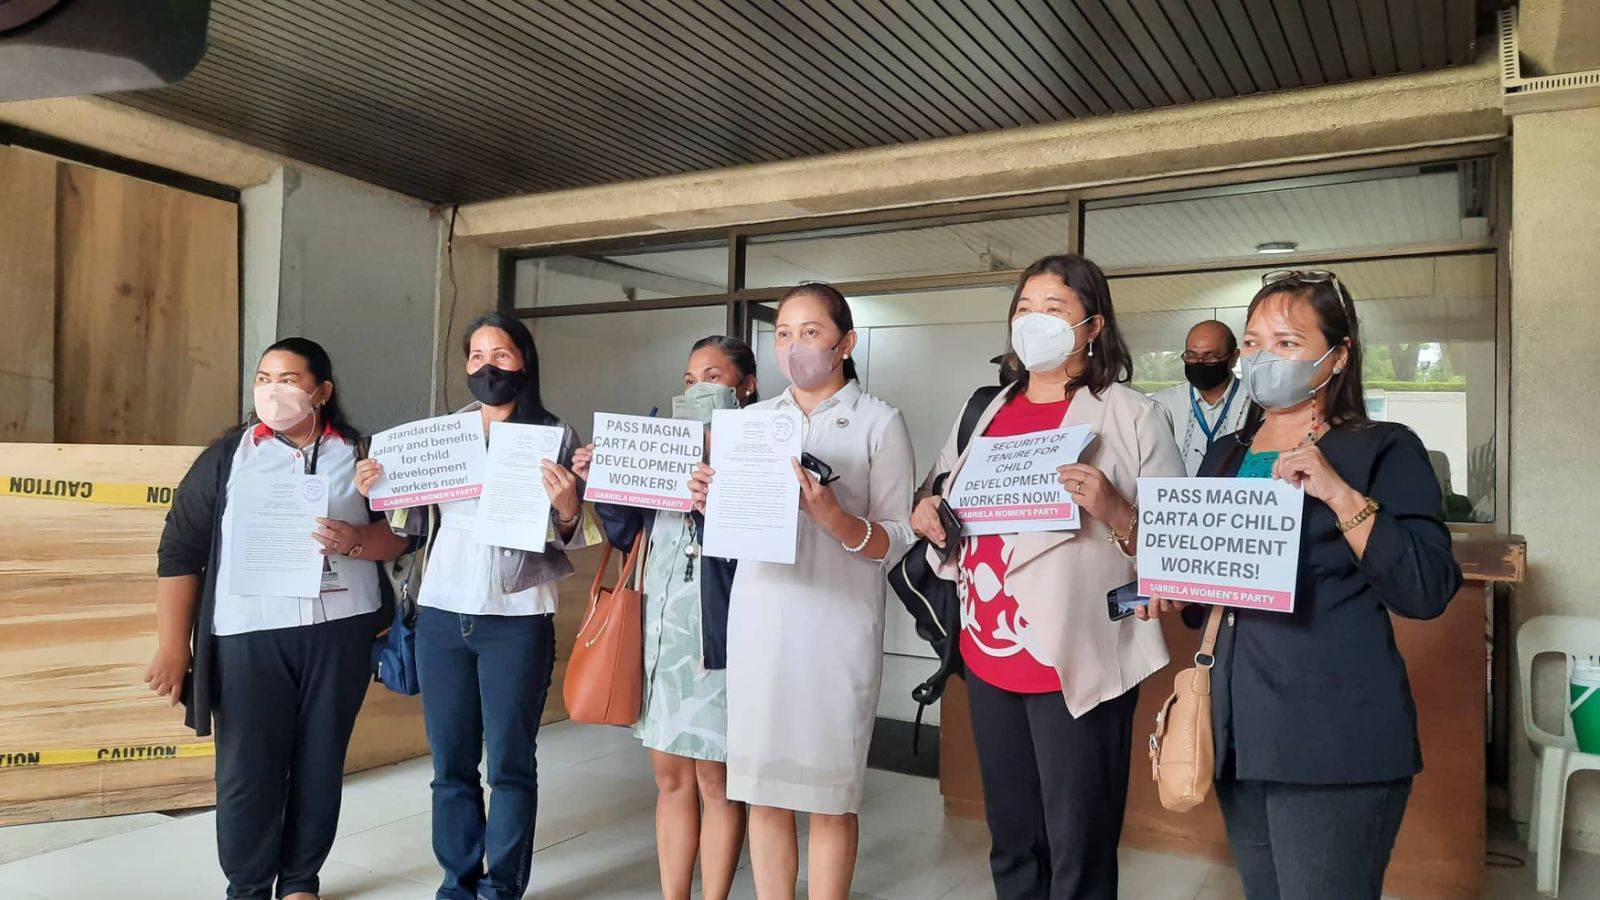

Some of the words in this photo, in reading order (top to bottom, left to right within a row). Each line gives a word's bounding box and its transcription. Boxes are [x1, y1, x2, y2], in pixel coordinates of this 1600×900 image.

[606, 420, 639, 433] PASS
[641, 423, 691, 438] MAGNA
[373, 444, 403, 458] salary
[407, 438, 429, 450] and
[431, 432, 479, 447] benefits
[594, 436, 637, 450] CARTA
[640, 440, 657, 453] OF
[660, 443, 701, 457] CHILD
[990, 438, 1047, 451] SECURITY
[1050, 433, 1069, 443] OF
[400, 454, 418, 465] for
[420, 450, 450, 463] child
[986, 449, 1030, 463] TENURE
[1033, 445, 1060, 457] FOR
[389, 462, 467, 481] development
[595, 453, 696, 475] DEVELOPMENT
[995, 461, 1033, 474] CHILD
[9, 476, 93, 499] CAUTION
[391, 482, 439, 495] workers
[441, 475, 469, 486] now!
[609, 472, 677, 491] WORKERS!
[964, 472, 1058, 491] DEVELOPMENT
[383, 497, 420, 507] GABRIELA
[419, 492, 456, 502] WOMEN'S
[455, 487, 478, 496] PARTY
[594, 491, 628, 502] GABRIELA
[660, 498, 684, 508] PARTY
[959, 492, 1019, 508] WORKERS
[1022, 490, 1060, 504] NOW!
[1157, 488, 1202, 503] PASS
[1206, 489, 1278, 506] MAGNA
[958, 510, 994, 519] GABRIELA
[994, 508, 1032, 518] WOMEN'S
[1033, 506, 1060, 516] PARTY
[1142, 510, 1199, 527] CARTA
[1202, 512, 1227, 528] OF
[1230, 513, 1296, 532] CHILD
[1145, 533, 1288, 557] DEVELOPMENT
[1161, 556, 1260, 580] WORKERS!
[1150, 583, 1189, 596] GABRIELA
[1190, 586, 1239, 601] WOMEN'S
[1240, 592, 1276, 605] PARTY
